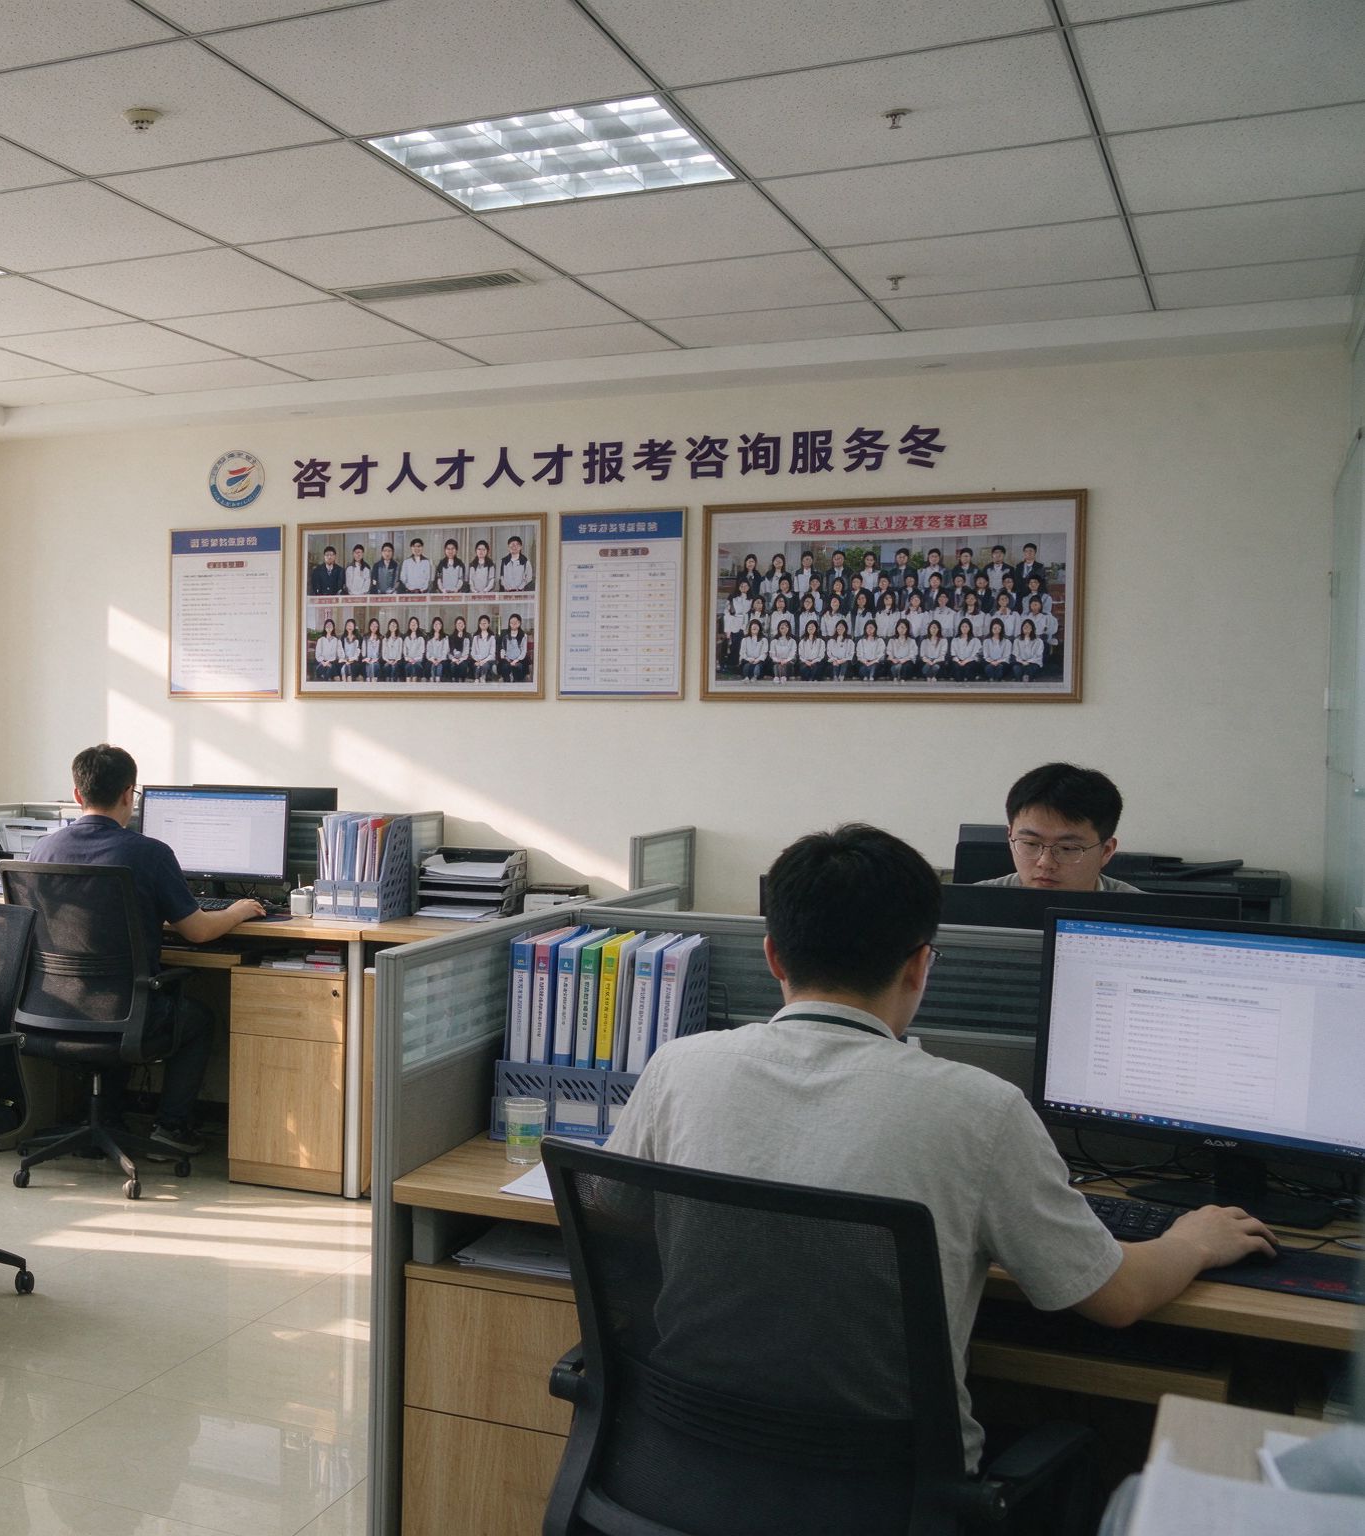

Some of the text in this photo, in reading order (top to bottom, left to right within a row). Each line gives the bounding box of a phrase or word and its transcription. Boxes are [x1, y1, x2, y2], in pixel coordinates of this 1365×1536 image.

[291, 424, 948, 500] 咨才人才人才报考咨询服务冬
